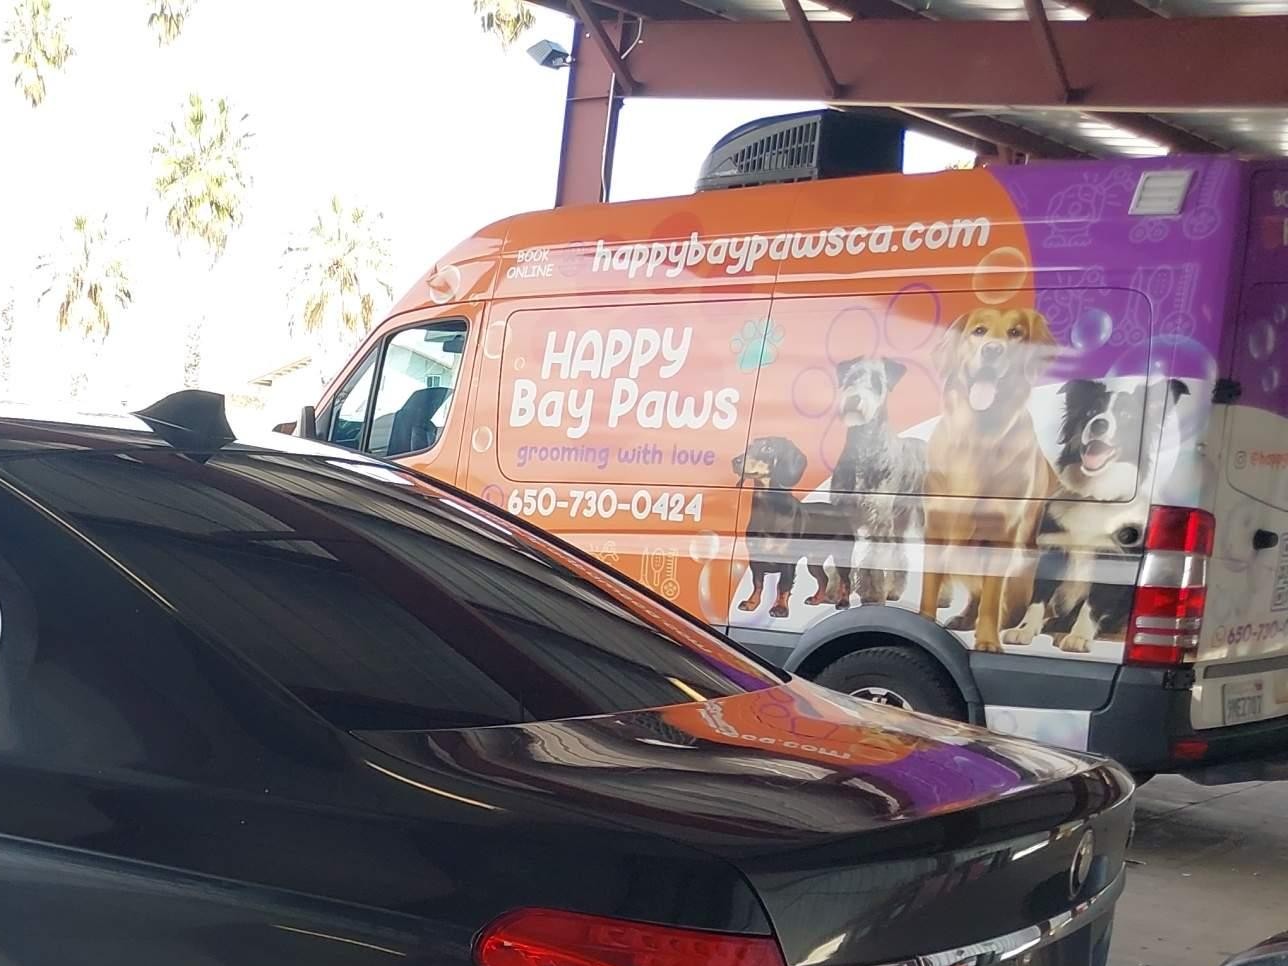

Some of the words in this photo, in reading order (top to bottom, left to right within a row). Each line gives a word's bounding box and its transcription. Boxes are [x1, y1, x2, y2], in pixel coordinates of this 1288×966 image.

[517, 248, 550, 263] BOOK
[592, 217, 990, 278] happybaypawsca.com
[506, 263, 554, 279] ONLINE
[541, 327, 693, 379] HAPPY
[510, 379, 594, 439] Bay
[608, 377, 740, 430] Paws
[517, 443, 610, 469] grooming
[617, 443, 662, 465] with
[672, 443, 716, 466] love
[507, 487, 703, 522] 650-730-0424
